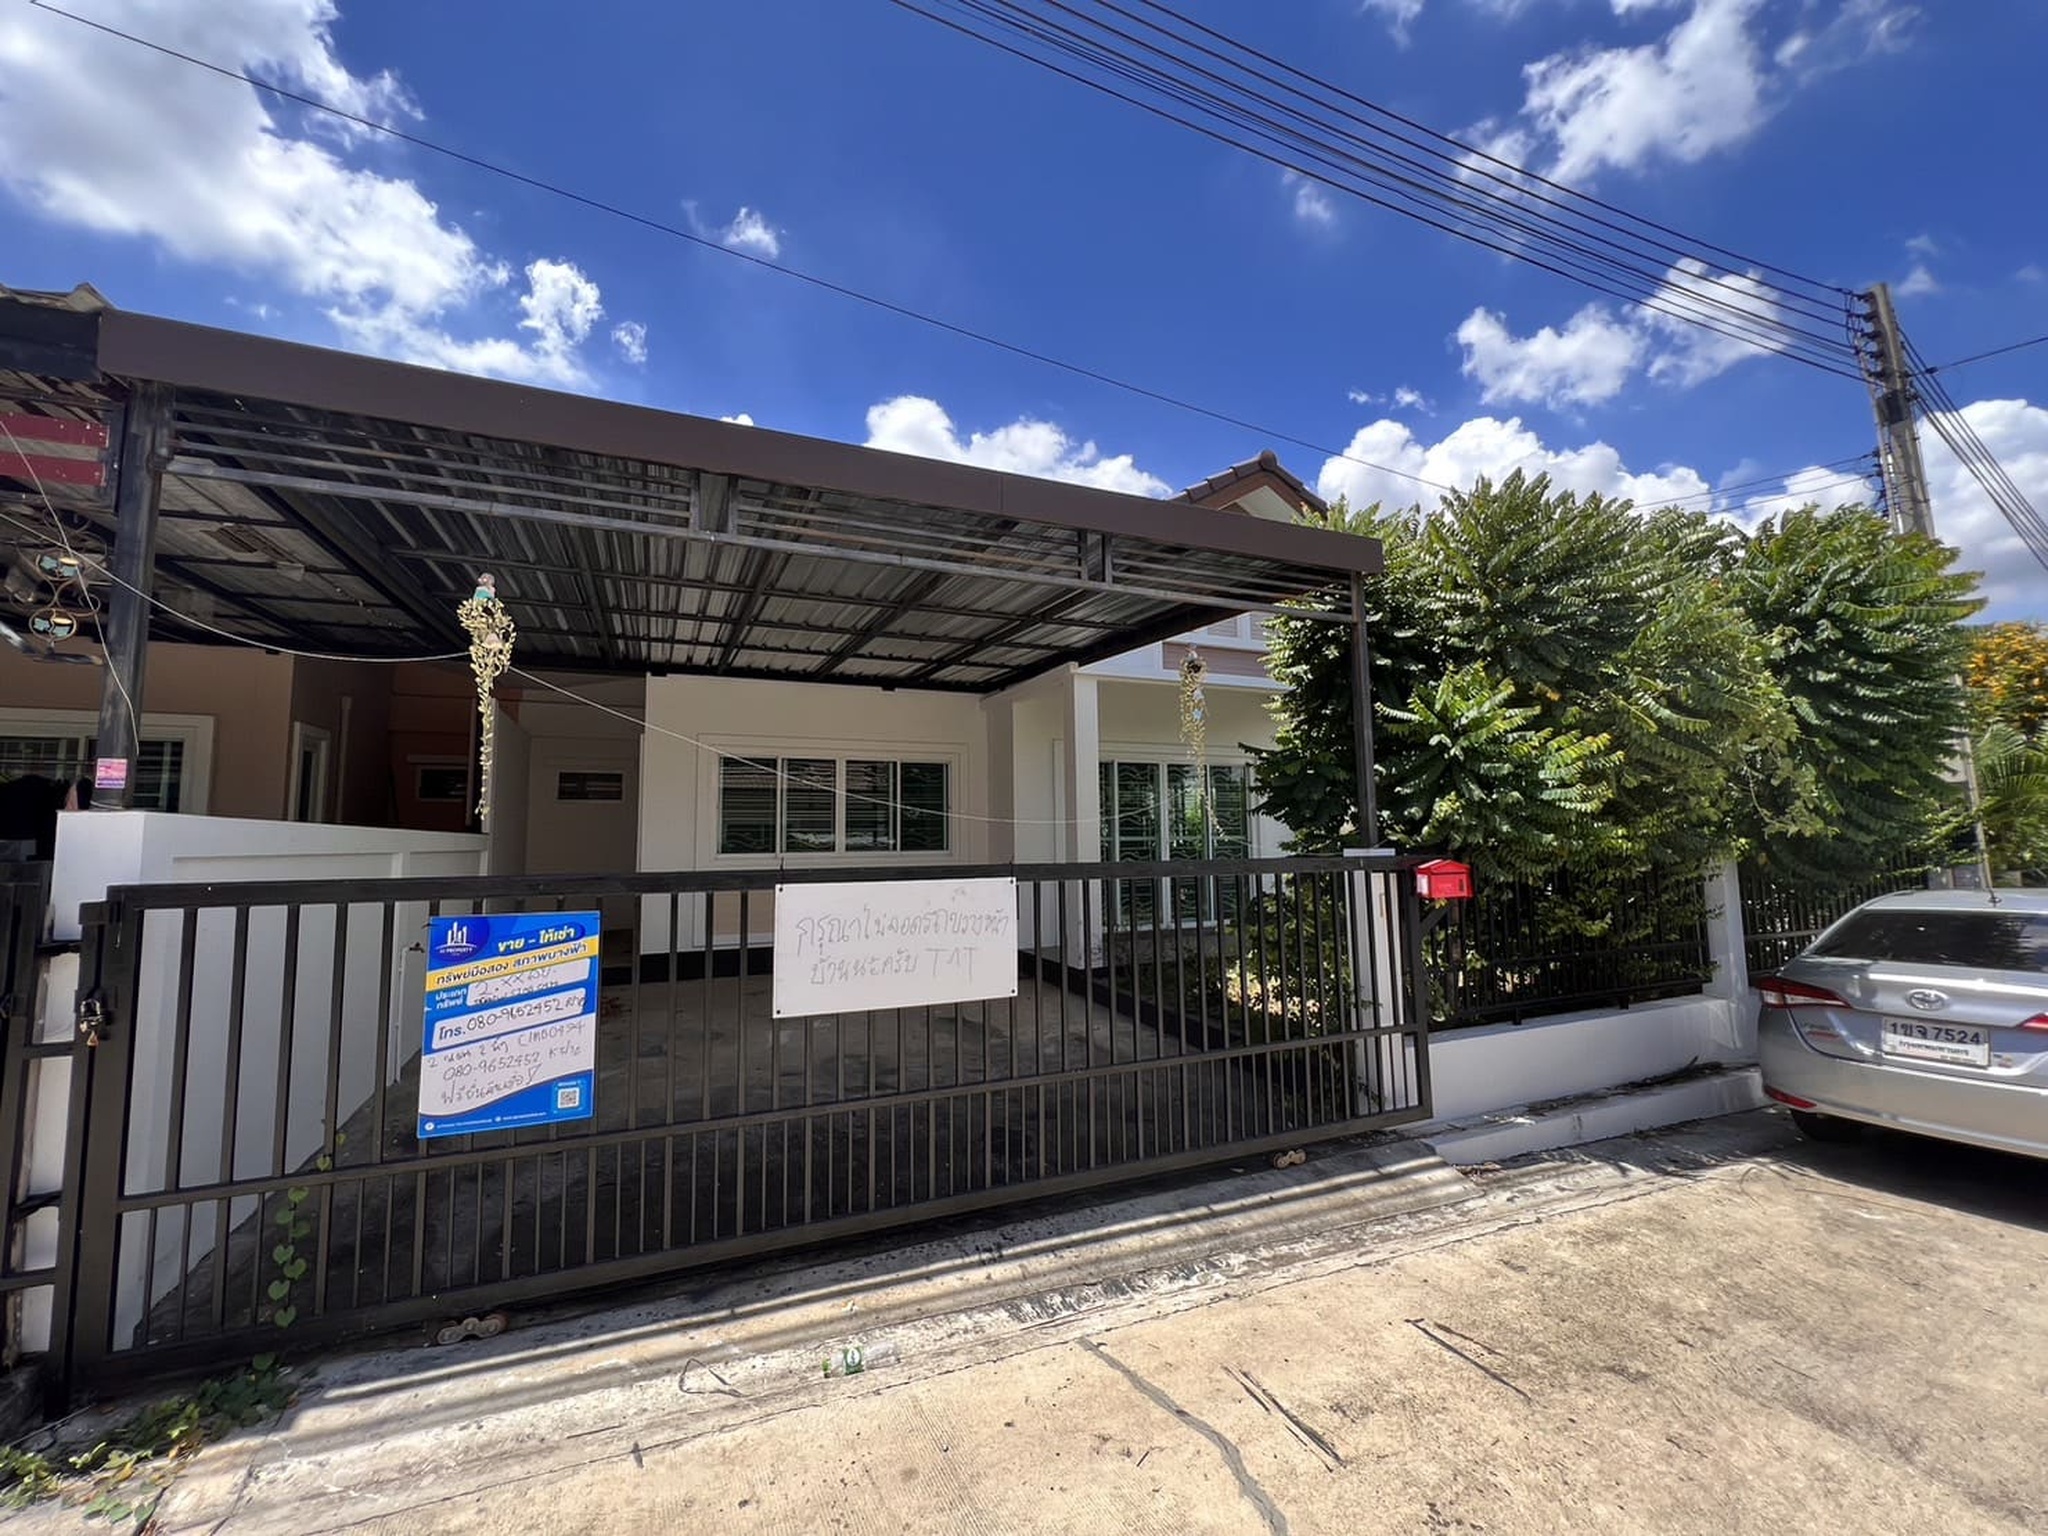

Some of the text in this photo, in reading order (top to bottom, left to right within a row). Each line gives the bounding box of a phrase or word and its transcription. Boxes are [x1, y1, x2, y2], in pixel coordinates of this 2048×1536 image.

[498, 937, 524, 952] ขาย
[439, 1025, 466, 1041] โทร.
[1931, 1026, 1981, 1045] 7524
